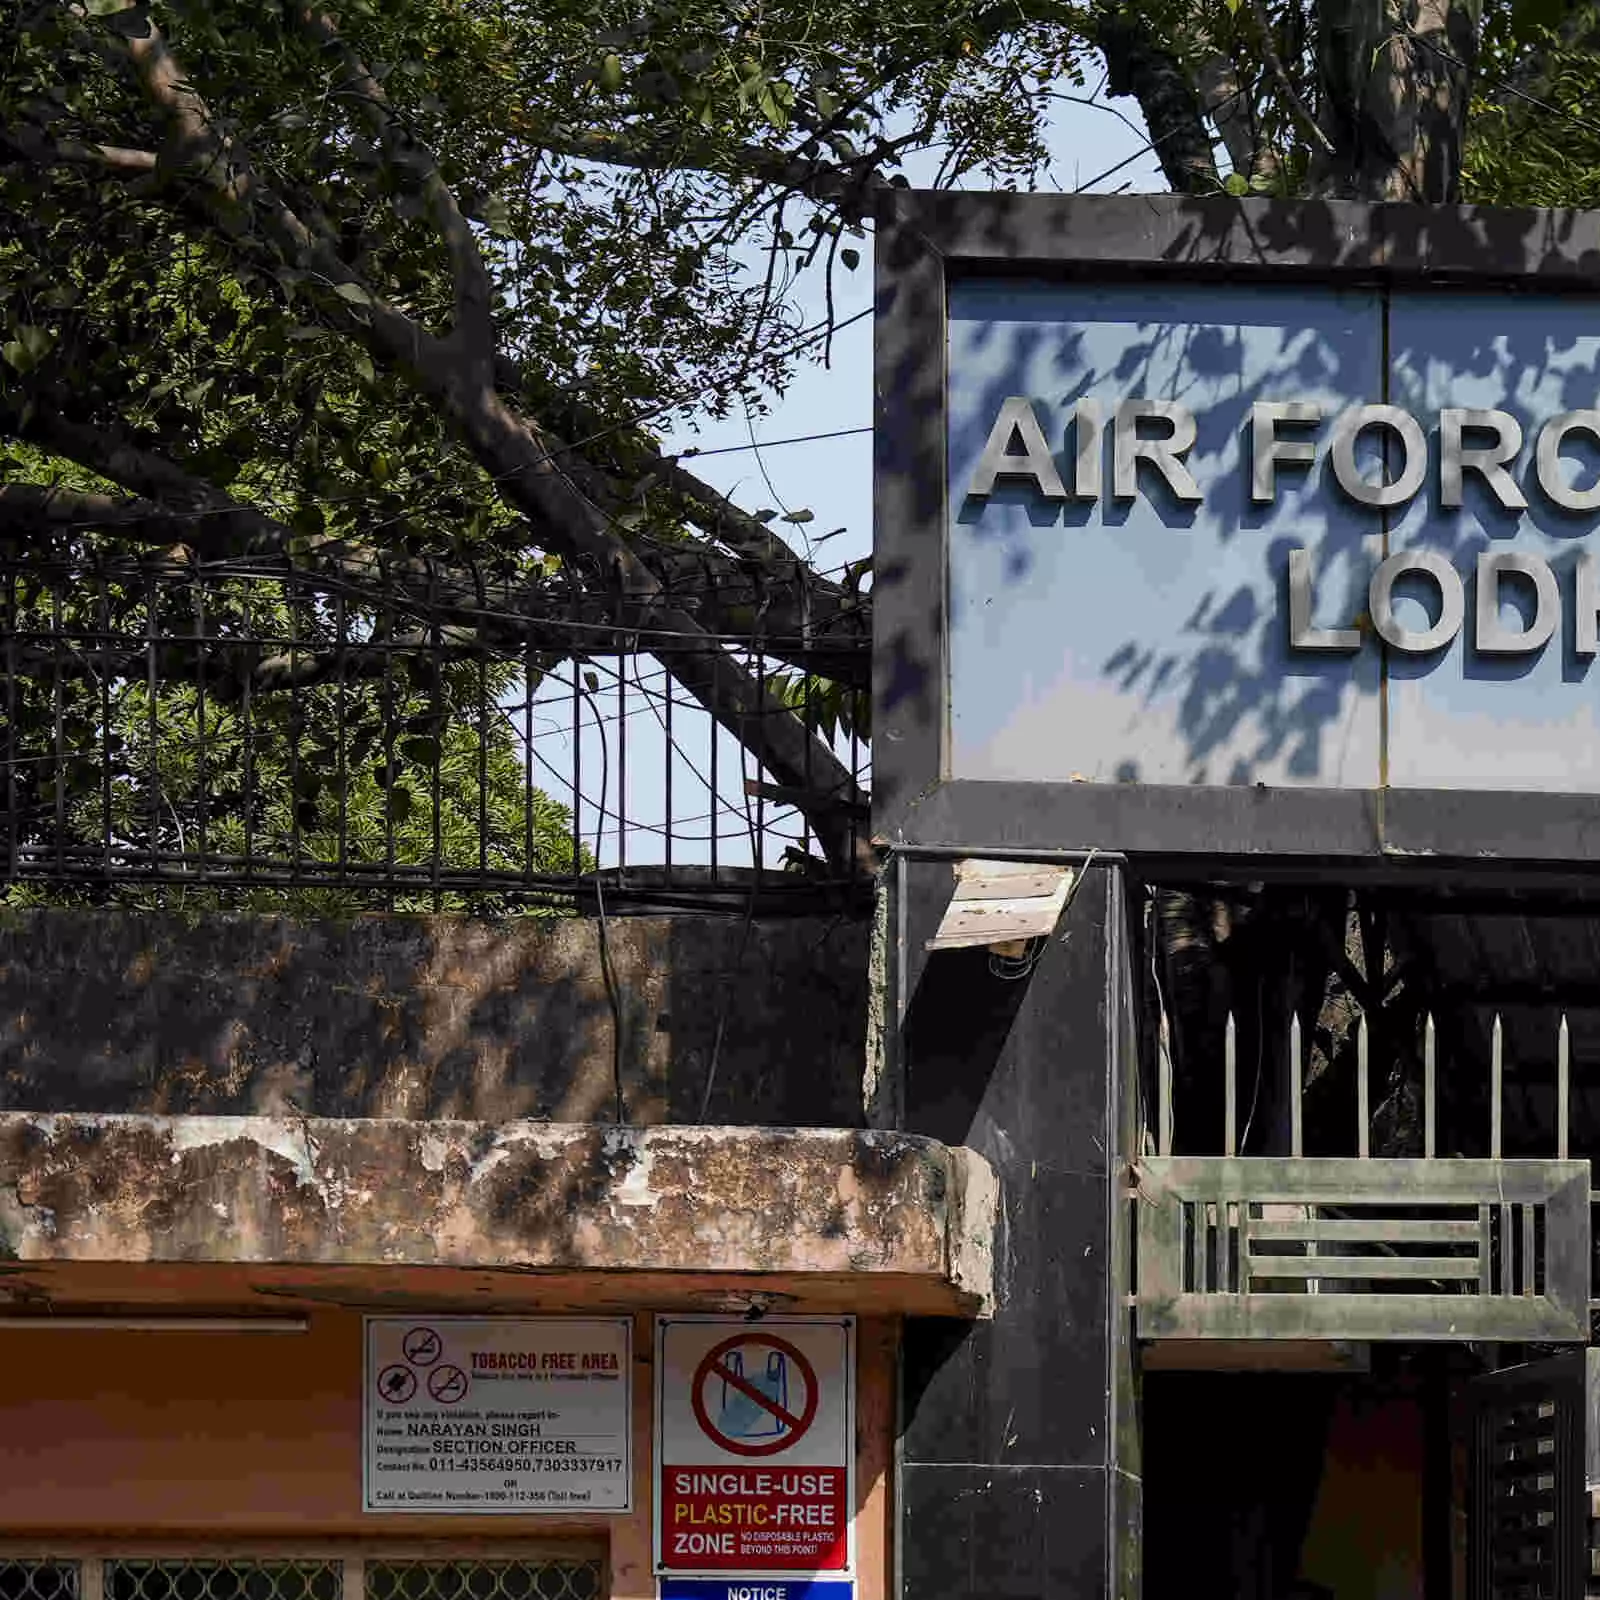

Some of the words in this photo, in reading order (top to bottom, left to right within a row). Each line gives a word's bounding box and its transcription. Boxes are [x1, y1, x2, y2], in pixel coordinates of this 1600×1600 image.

[966, 394, 1203, 501] AIR
[471, 1352, 537, 1369] TOBACCO
[541, 1352, 576, 1369] FREE
[582, 1352, 618, 1369] AREA
[407, 1423, 487, 1437] NARAYAN
[491, 1423, 541, 1437] SINGH
[432, 1439, 503, 1454] SECTION
[507, 1440, 577, 1454] OFFICER
[674, 1473, 836, 1496] SINGLE-USE
[674, 1503, 836, 1526] PLASTIC-FREE
[673, 1532, 736, 1555] ZONE
